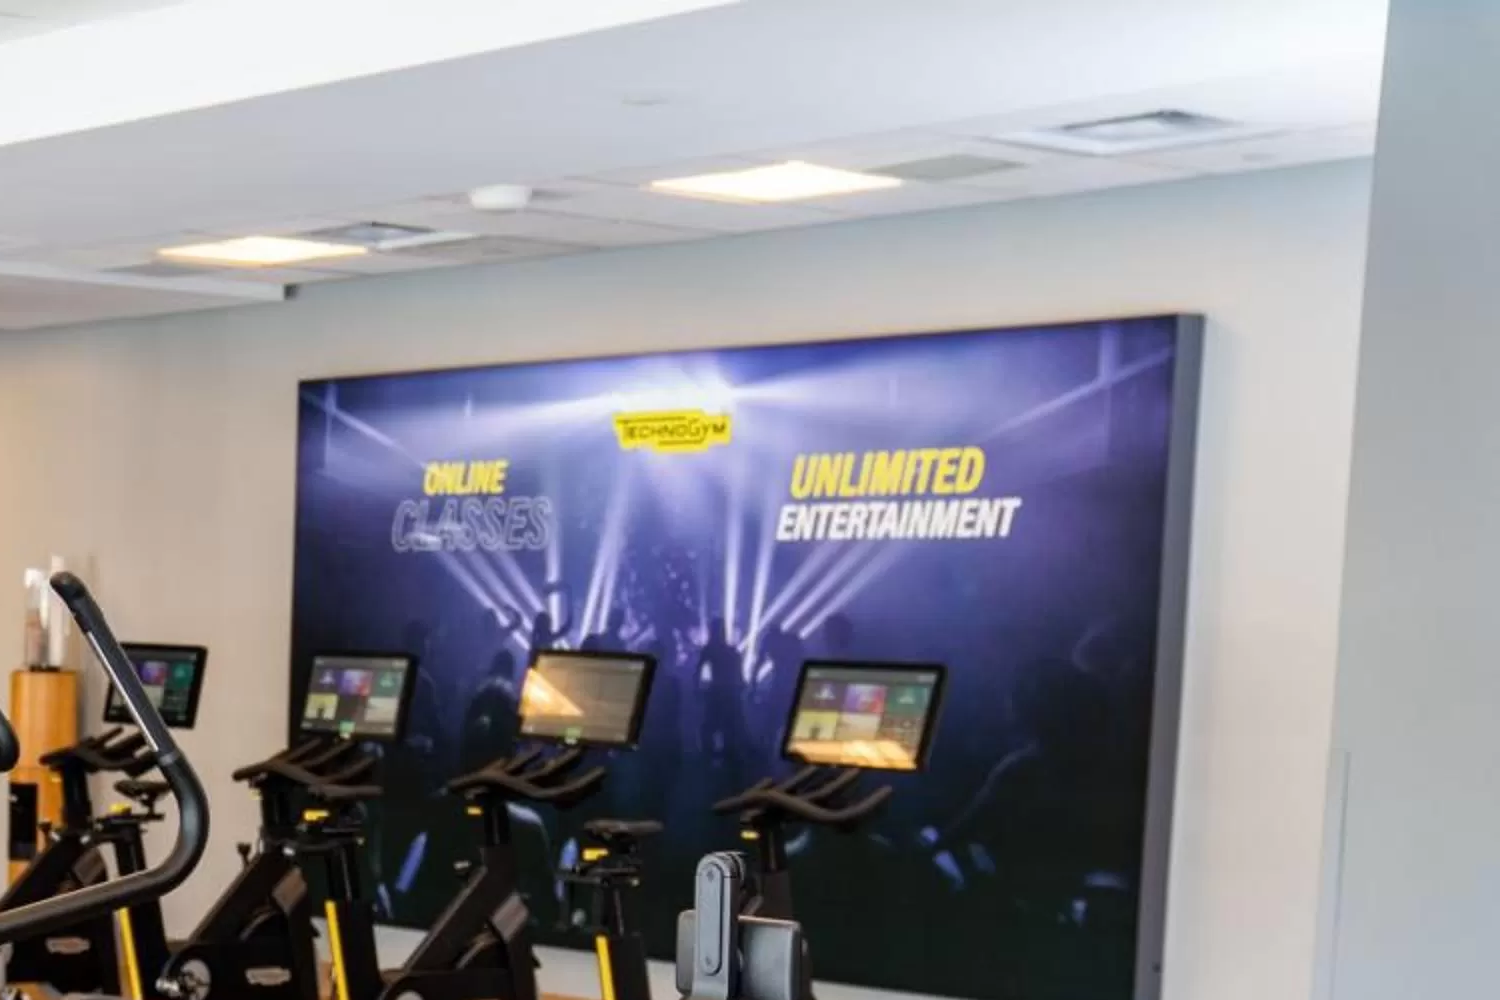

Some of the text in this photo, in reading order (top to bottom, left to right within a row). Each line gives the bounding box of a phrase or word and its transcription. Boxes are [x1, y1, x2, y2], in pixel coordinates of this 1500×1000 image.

[423, 459, 508, 495] ONLINE
[790, 446, 985, 499] UNLIMITED
[391, 496, 552, 552] CLASSES
[775, 497, 1022, 541] ENTERTAINMENT
